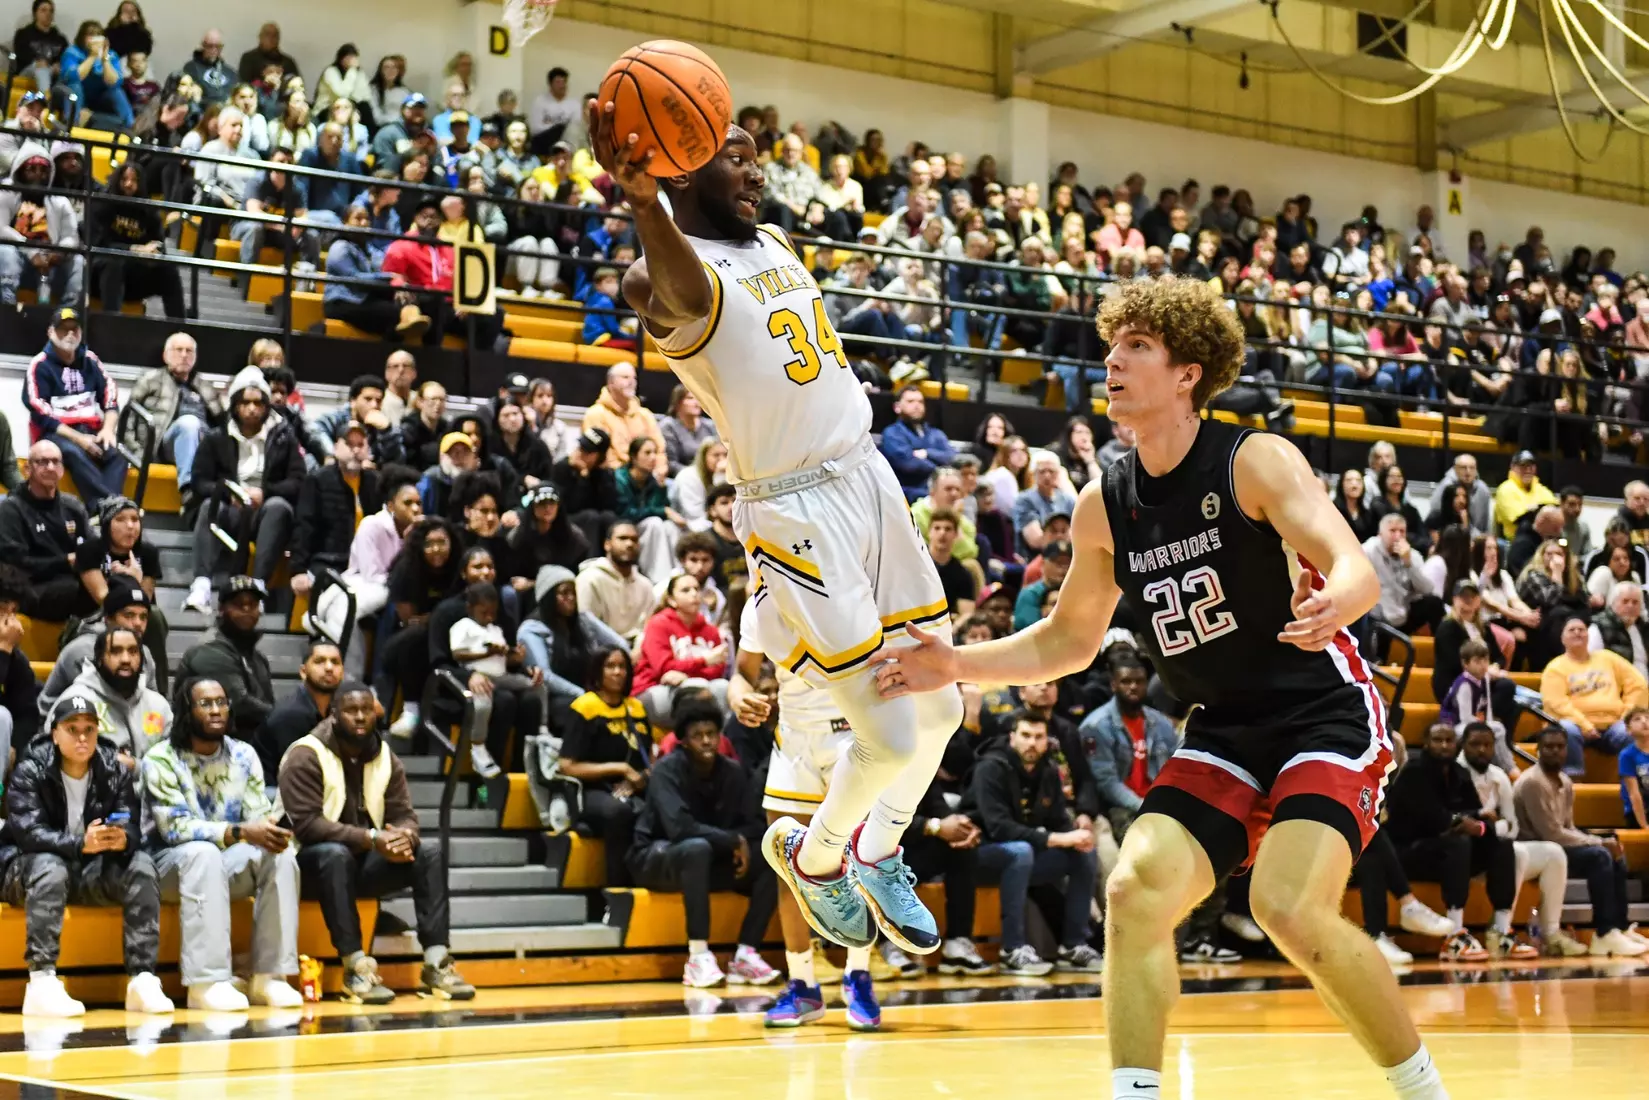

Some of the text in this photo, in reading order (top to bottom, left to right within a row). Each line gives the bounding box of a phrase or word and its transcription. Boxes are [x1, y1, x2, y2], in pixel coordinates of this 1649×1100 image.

[489, 25, 510, 55] D
[1448, 190, 1461, 215] A
[458, 245, 490, 307] D
[766, 296, 848, 386] 34
[1128, 526, 1223, 574] WARRIORS
[1142, 564, 1240, 658] 22
